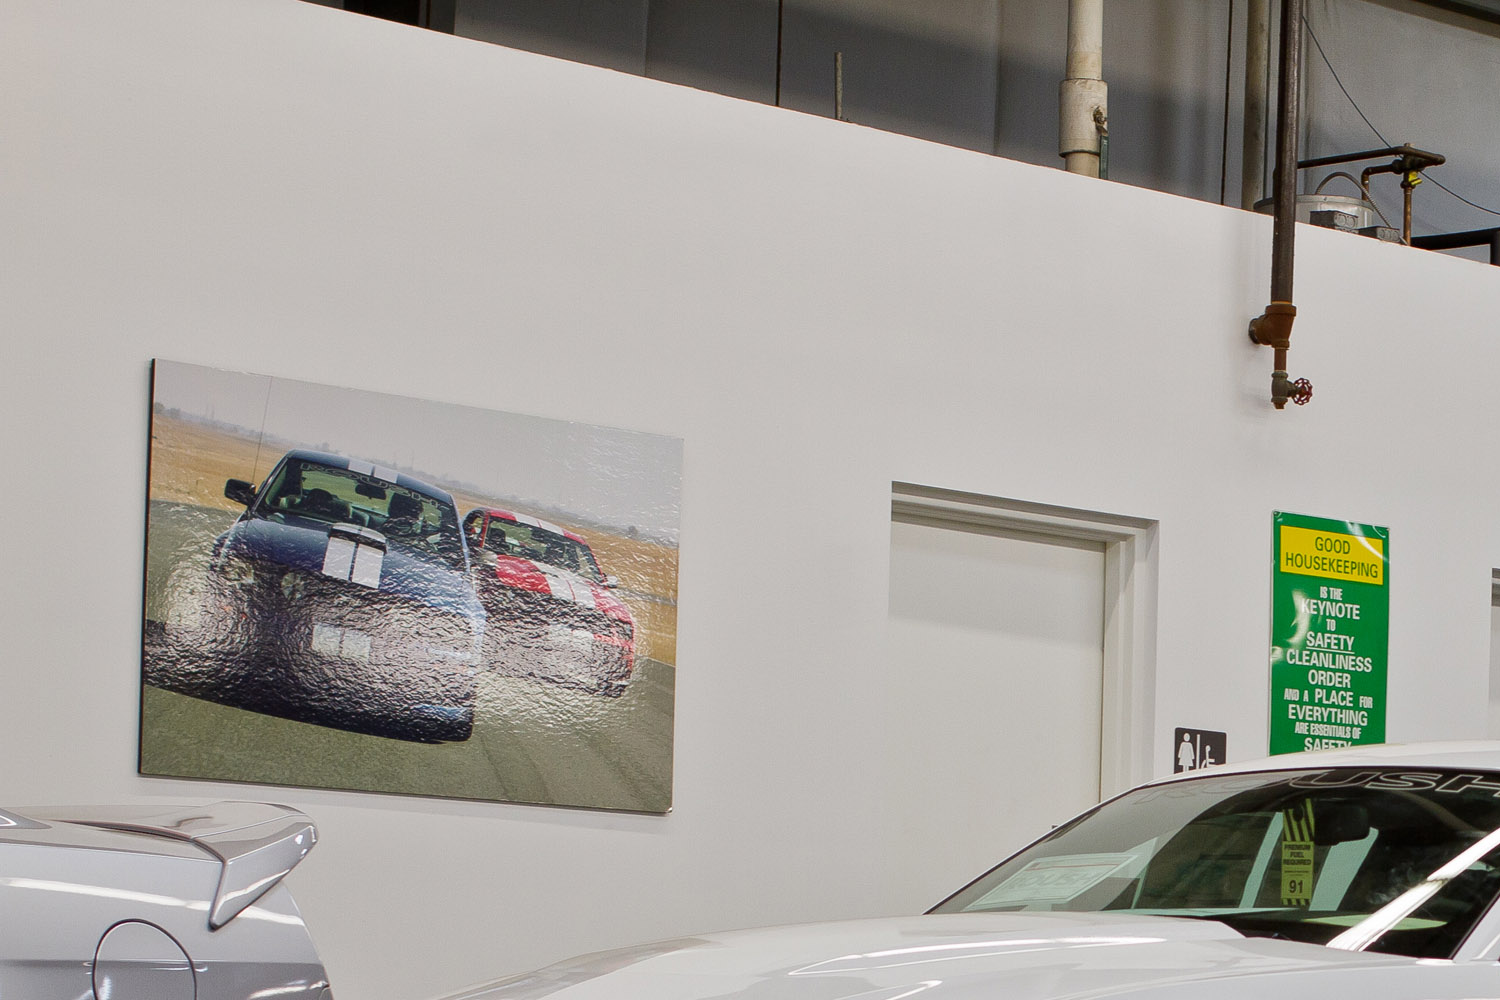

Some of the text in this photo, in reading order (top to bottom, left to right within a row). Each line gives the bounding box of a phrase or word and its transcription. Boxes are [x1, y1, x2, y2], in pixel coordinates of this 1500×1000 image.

[1314, 536, 1351, 555] GOOD
[1285, 551, 1379, 579] HOUSEKEEPING
[1319, 586, 1343, 601] IS THE
[1301, 598, 1361, 620] KEYNOTE
[1326, 618, 1337, 632] TO
[1305, 631, 1355, 652] SAFETY
[1286, 648, 1373, 673] CLEANLINESS
[1307, 669, 1352, 689] ORDER
[1284, 688, 1374, 709] AND A PLACE FOR
[1288, 703, 1369, 727] EVERYTHING
[1294, 721, 1362, 740] ARE ESSENTIALS OF
[1289, 880, 1304, 894] 91
